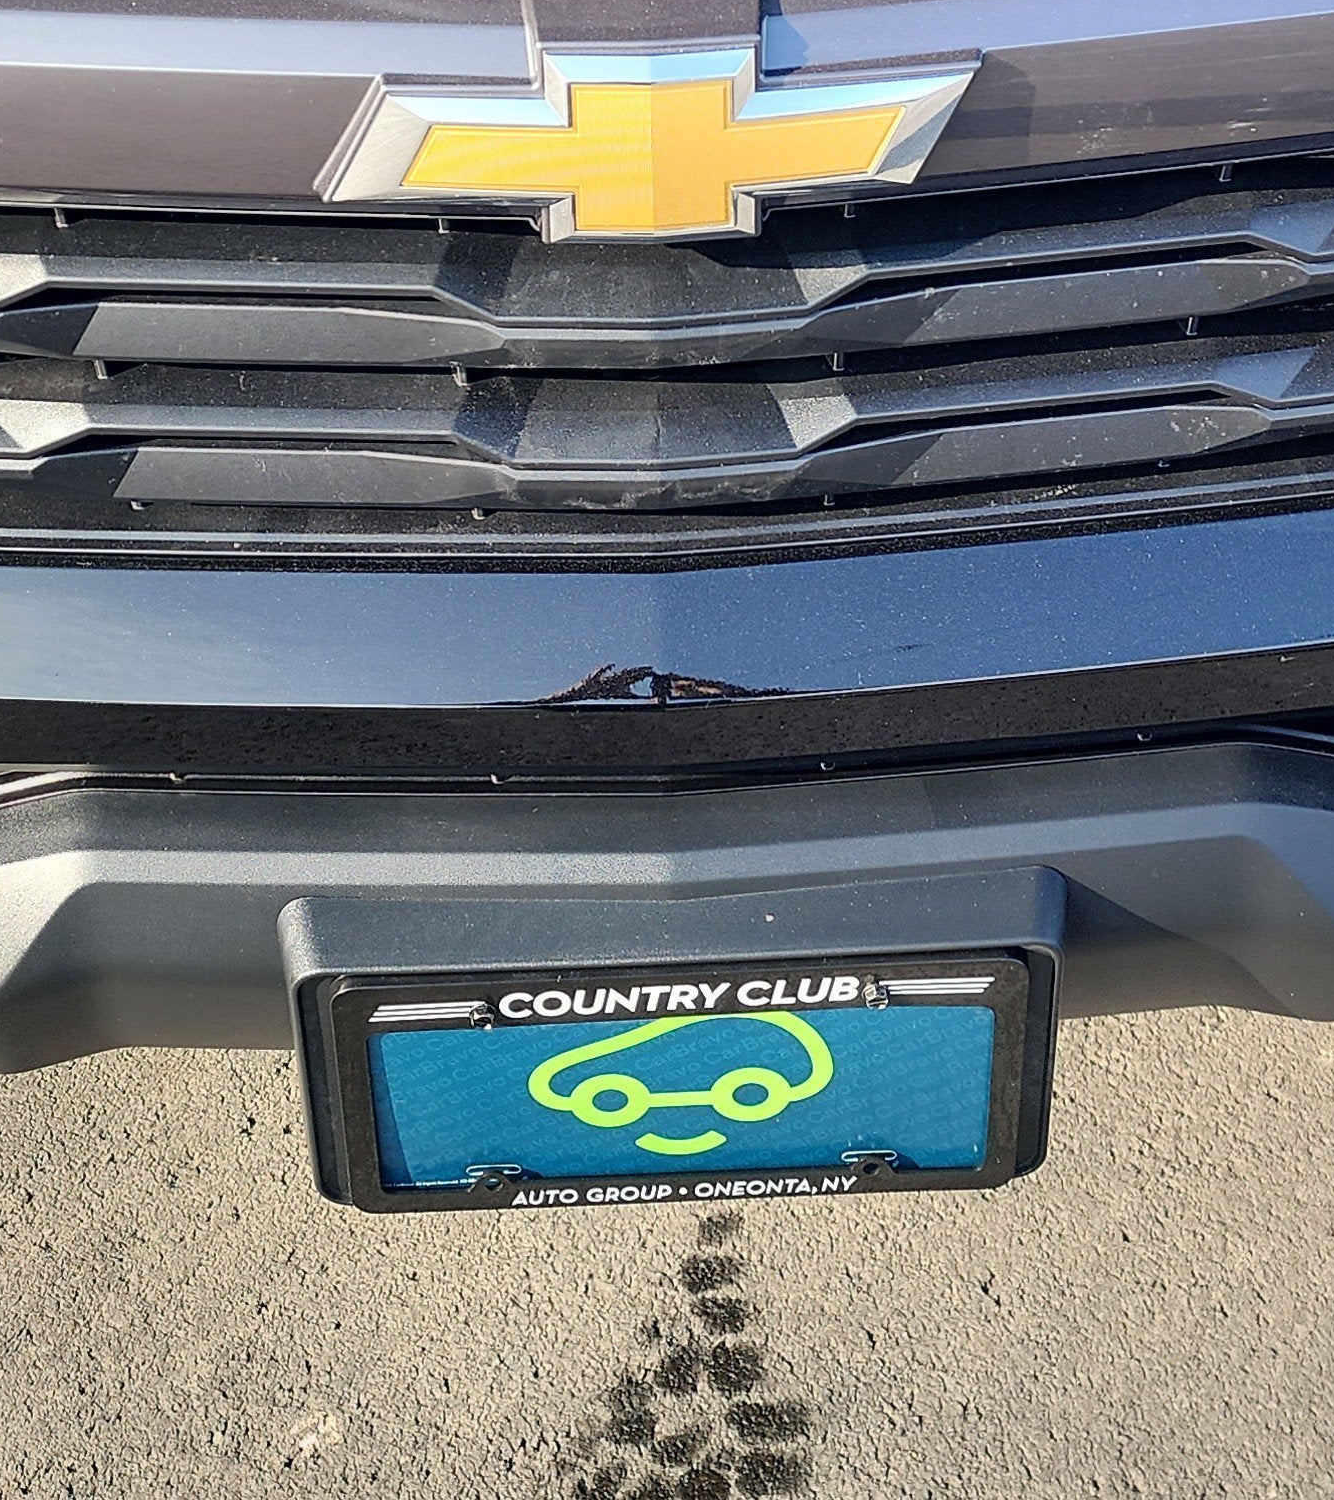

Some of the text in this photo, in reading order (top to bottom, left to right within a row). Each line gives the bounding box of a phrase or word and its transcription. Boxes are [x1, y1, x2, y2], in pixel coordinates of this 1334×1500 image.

[498, 976, 859, 1019] COUNTRY CLUB
[511, 1189, 578, 1206] AUTO
[585, 1184, 672, 1203] GROUP
